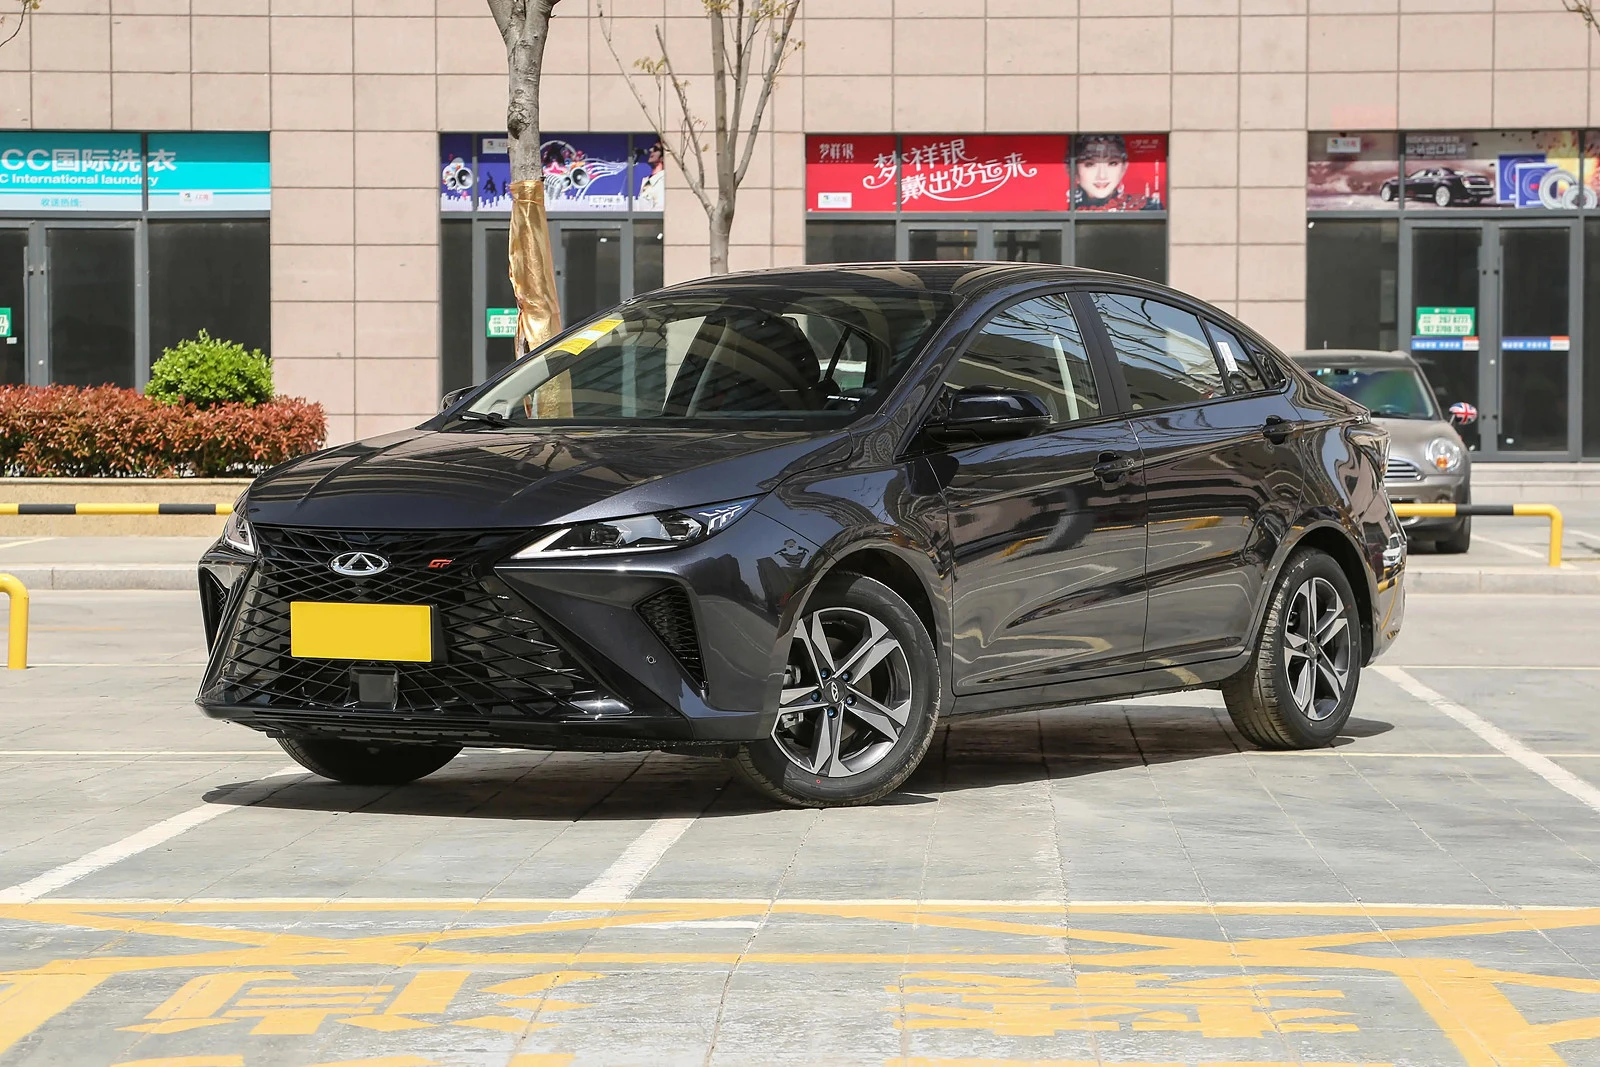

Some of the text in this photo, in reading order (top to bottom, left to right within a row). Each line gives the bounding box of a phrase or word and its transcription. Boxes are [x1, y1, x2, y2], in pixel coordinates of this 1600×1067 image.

[863, 138, 978, 189] 梦祥银
[893, 152, 1038, 205] 戴出好运来
[12, 174, 98, 184] International
[427, 559, 453, 568] GT
